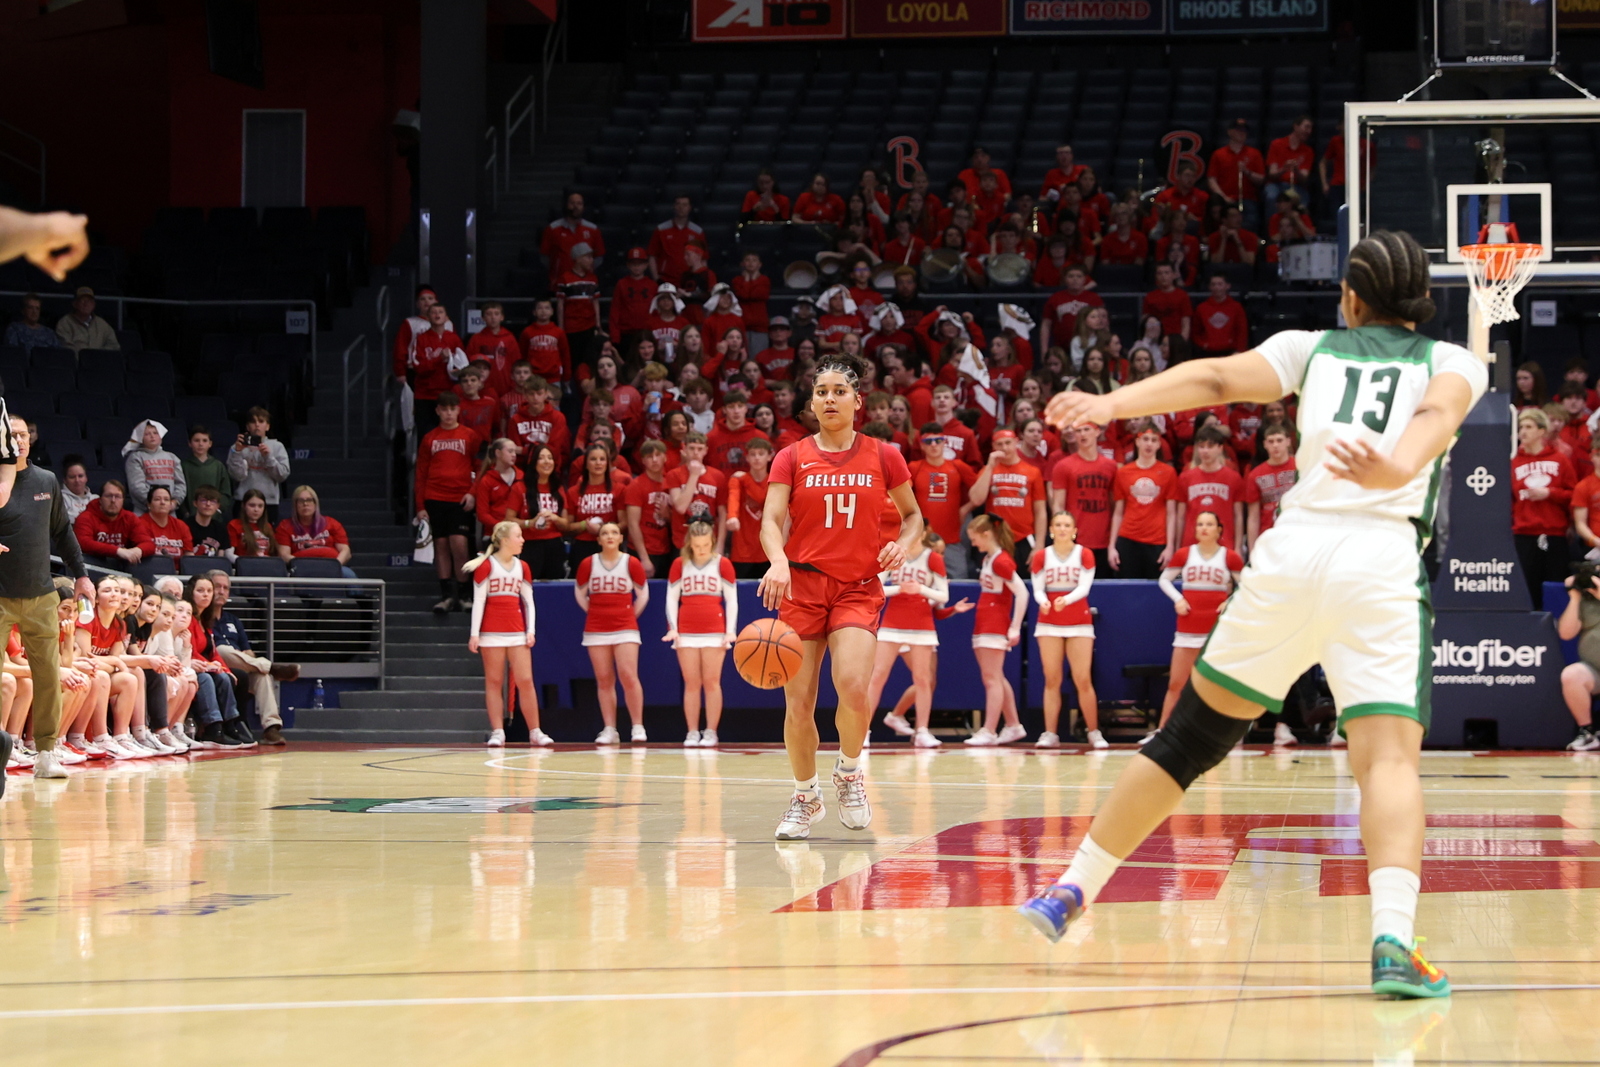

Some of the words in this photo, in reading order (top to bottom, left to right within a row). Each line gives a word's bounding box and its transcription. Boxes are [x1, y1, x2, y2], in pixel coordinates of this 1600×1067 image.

[886, 2, 969, 23] LOYOLA
[1025, 1, 1151, 20] RICHMOND
[1179, 1, 1242, 19] RHODE
[1249, 0, 1317, 17] ISLAND
[1466, 55, 1525, 63] DAKTRONICS
[886, 135, 925, 190] B
[1160, 130, 1206, 185] B
[289, 318, 306, 327] 107
[1333, 366, 1402, 434] 13
[294, 449, 310, 459] 107
[805, 474, 874, 488] BELLEVUE
[823, 493, 857, 529] 14
[391, 555, 409, 566] 108
[1449, 558, 1515, 574] Premier
[683, 574, 717, 592] BHS
[1046, 566, 1081, 585] BHS
[1187, 565, 1224, 585] BHS
[1454, 575, 1510, 592] Health
[490, 577, 522, 593] BHS
[591, 576, 628, 593] BHS
[1432, 673, 1494, 686] connecting
[1495, 674, 1536, 686] dayton
